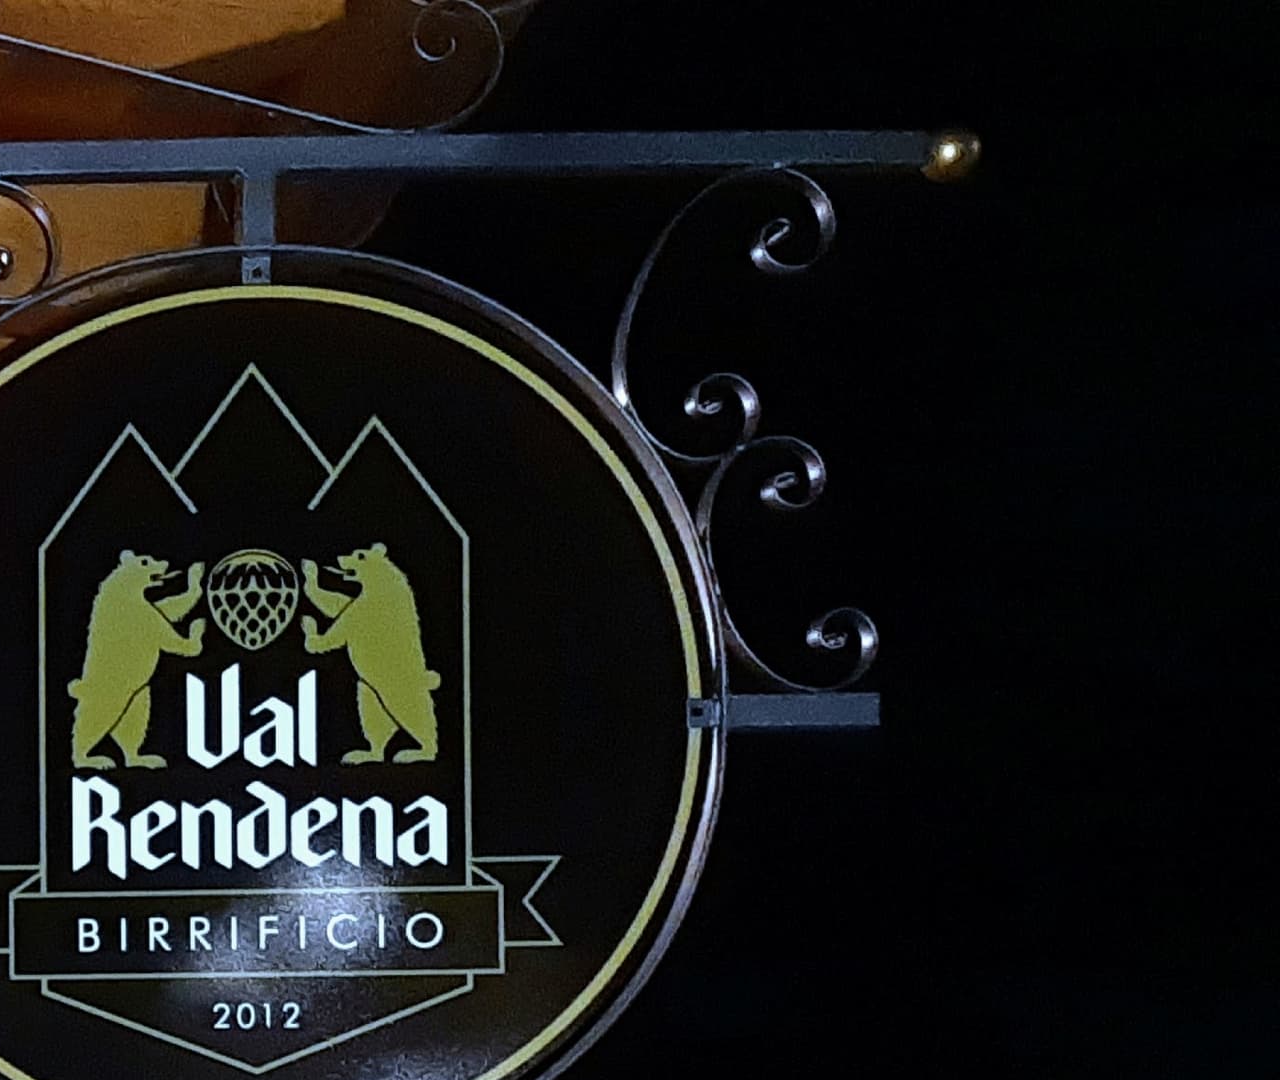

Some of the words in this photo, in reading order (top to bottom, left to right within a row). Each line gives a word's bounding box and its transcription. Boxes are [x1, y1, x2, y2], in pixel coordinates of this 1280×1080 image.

[185, 662, 318, 769] Val
[71, 775, 449, 879] Rendena
[77, 911, 445, 954] BIRRIFICIO
[211, 1001, 302, 1030] 2012
